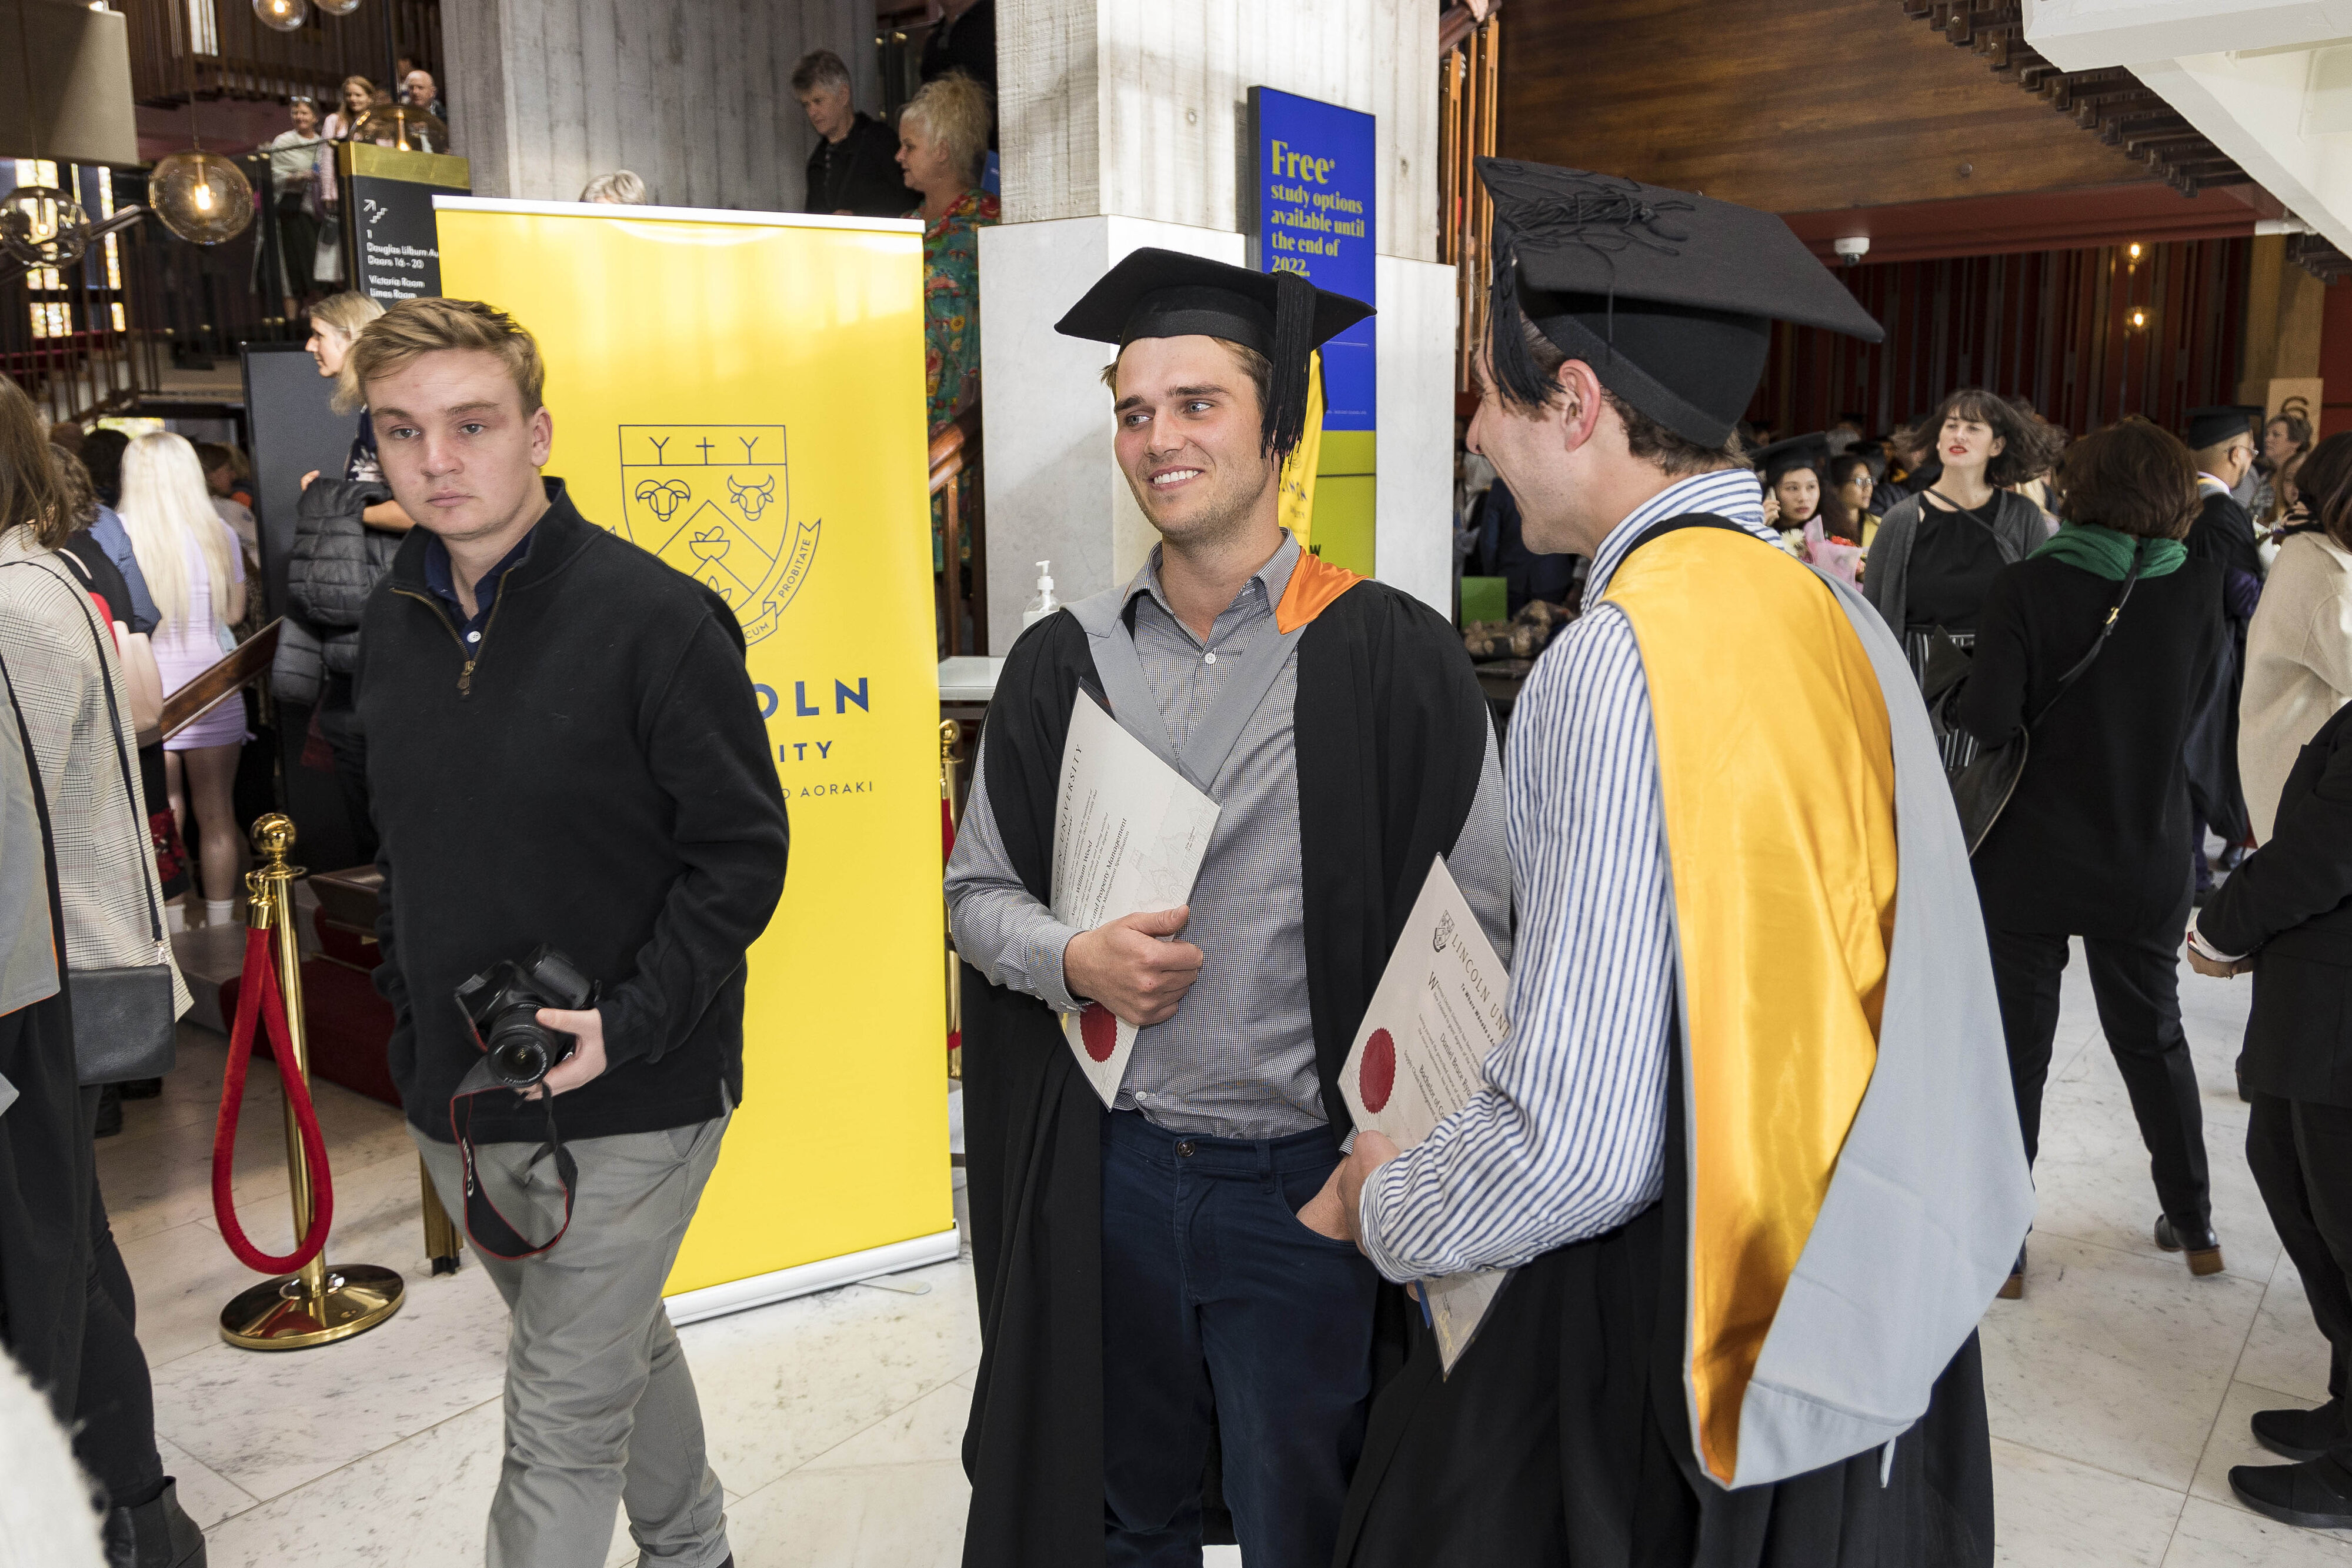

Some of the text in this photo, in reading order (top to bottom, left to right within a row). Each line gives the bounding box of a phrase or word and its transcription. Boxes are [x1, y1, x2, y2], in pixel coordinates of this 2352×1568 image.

[1270, 184, 1363, 214] study options
[1270, 207, 1365, 238] available until
[366, 242, 401, 256] Douglas
[1271, 231, 1341, 257] the end of
[368, 255, 393, 267] Doors
[411, 258, 425, 269] 20
[1272, 255, 1311, 277] 2022.
[368, 275, 425, 288] Victoria Room
[369, 287, 418, 299] Limes Room
[778, 539, 812, 599] PROBITATE
[800, 780, 873, 798] AORAKI
[1060, 743, 1082, 843] UNIVERSITY
[1095, 832, 1103, 849] having
[1100, 810, 1109, 833] satisfied
[1075, 863, 1086, 893] William
[1082, 839, 1093, 862] Wood
[1096, 869, 1110, 903] Property
[1106, 817, 1127, 870] Management
[1095, 830, 1130, 926] Property Management Specialisation
[1451, 933, 1490, 1002] LINCOLN
[1439, 1032, 1454, 1060] Daniel
[1450, 1056, 1463, 1082] Bruce
[1418, 1063, 1435, 1099] Bachelor
[1433, 1097, 1440, 1108] of
